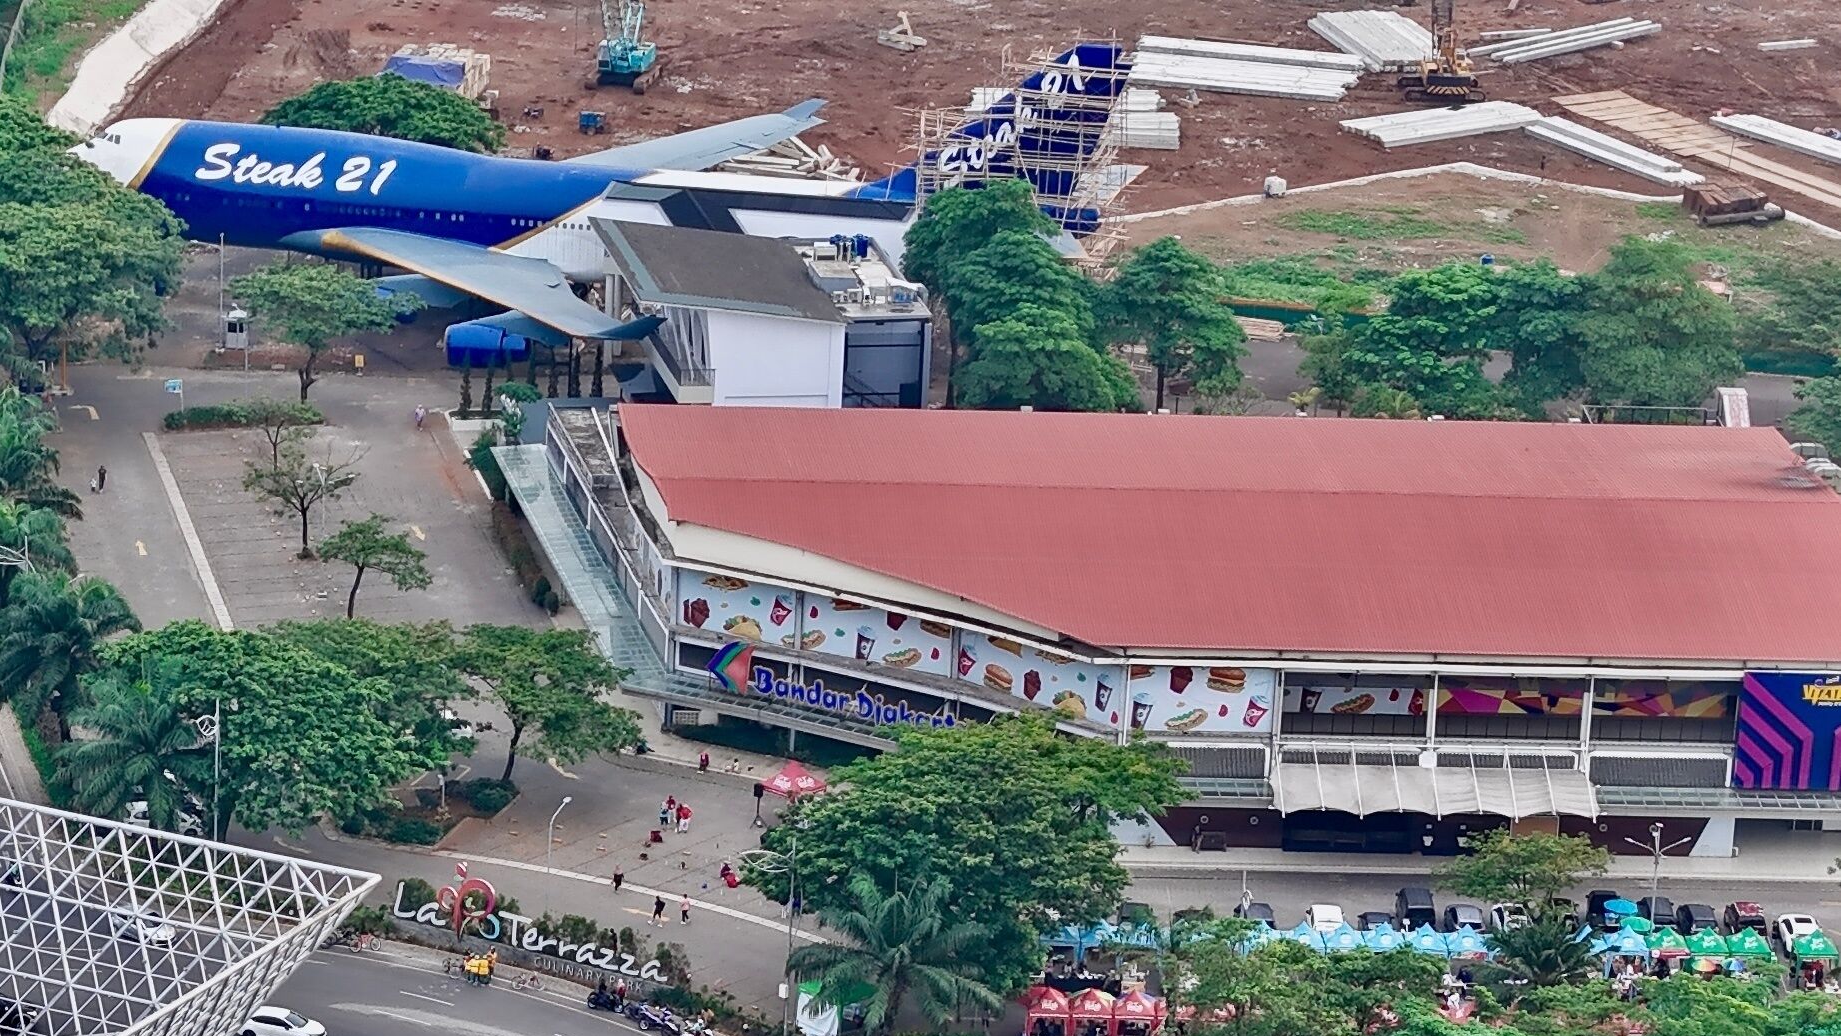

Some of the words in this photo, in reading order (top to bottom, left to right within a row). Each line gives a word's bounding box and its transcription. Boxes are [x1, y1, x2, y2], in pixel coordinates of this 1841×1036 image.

[195, 143, 326, 189] Steak
[335, 156, 397, 195] 21
[753, 665, 852, 711] Bandar
[393, 881, 447, 926] La
[498, 910, 669, 982] Terrazza
[534, 957, 603, 983] CULINARY
[609, 975, 643, 991] PRK
